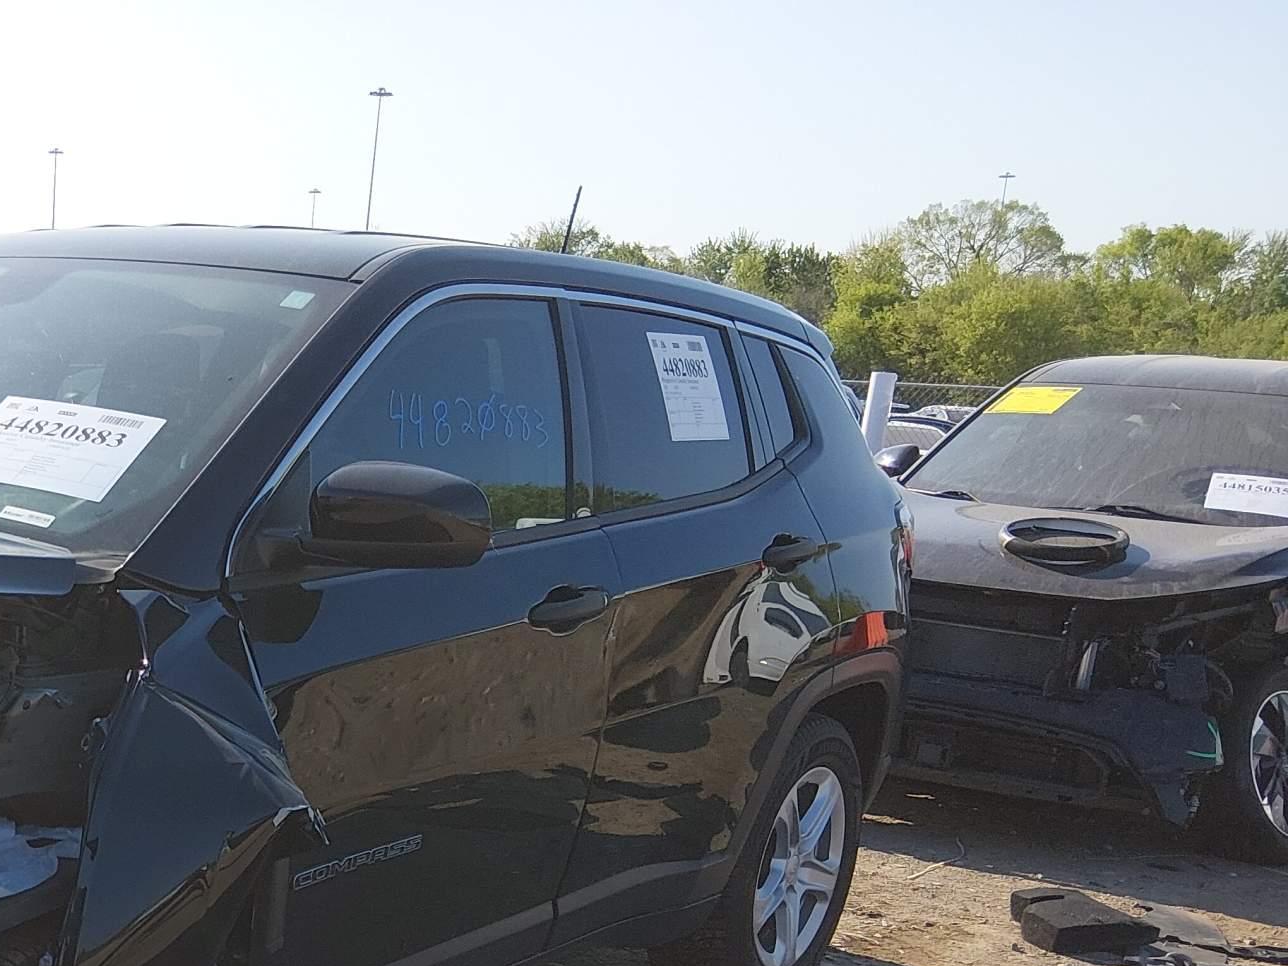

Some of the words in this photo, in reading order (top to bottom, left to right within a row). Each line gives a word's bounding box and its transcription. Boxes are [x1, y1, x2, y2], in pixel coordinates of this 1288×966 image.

[662, 357, 709, 378] 44820883
[0, 416, 128, 448] 44820883
[388, 389, 549, 448] 44820883
[293, 834, 424, 891] COMPASS
